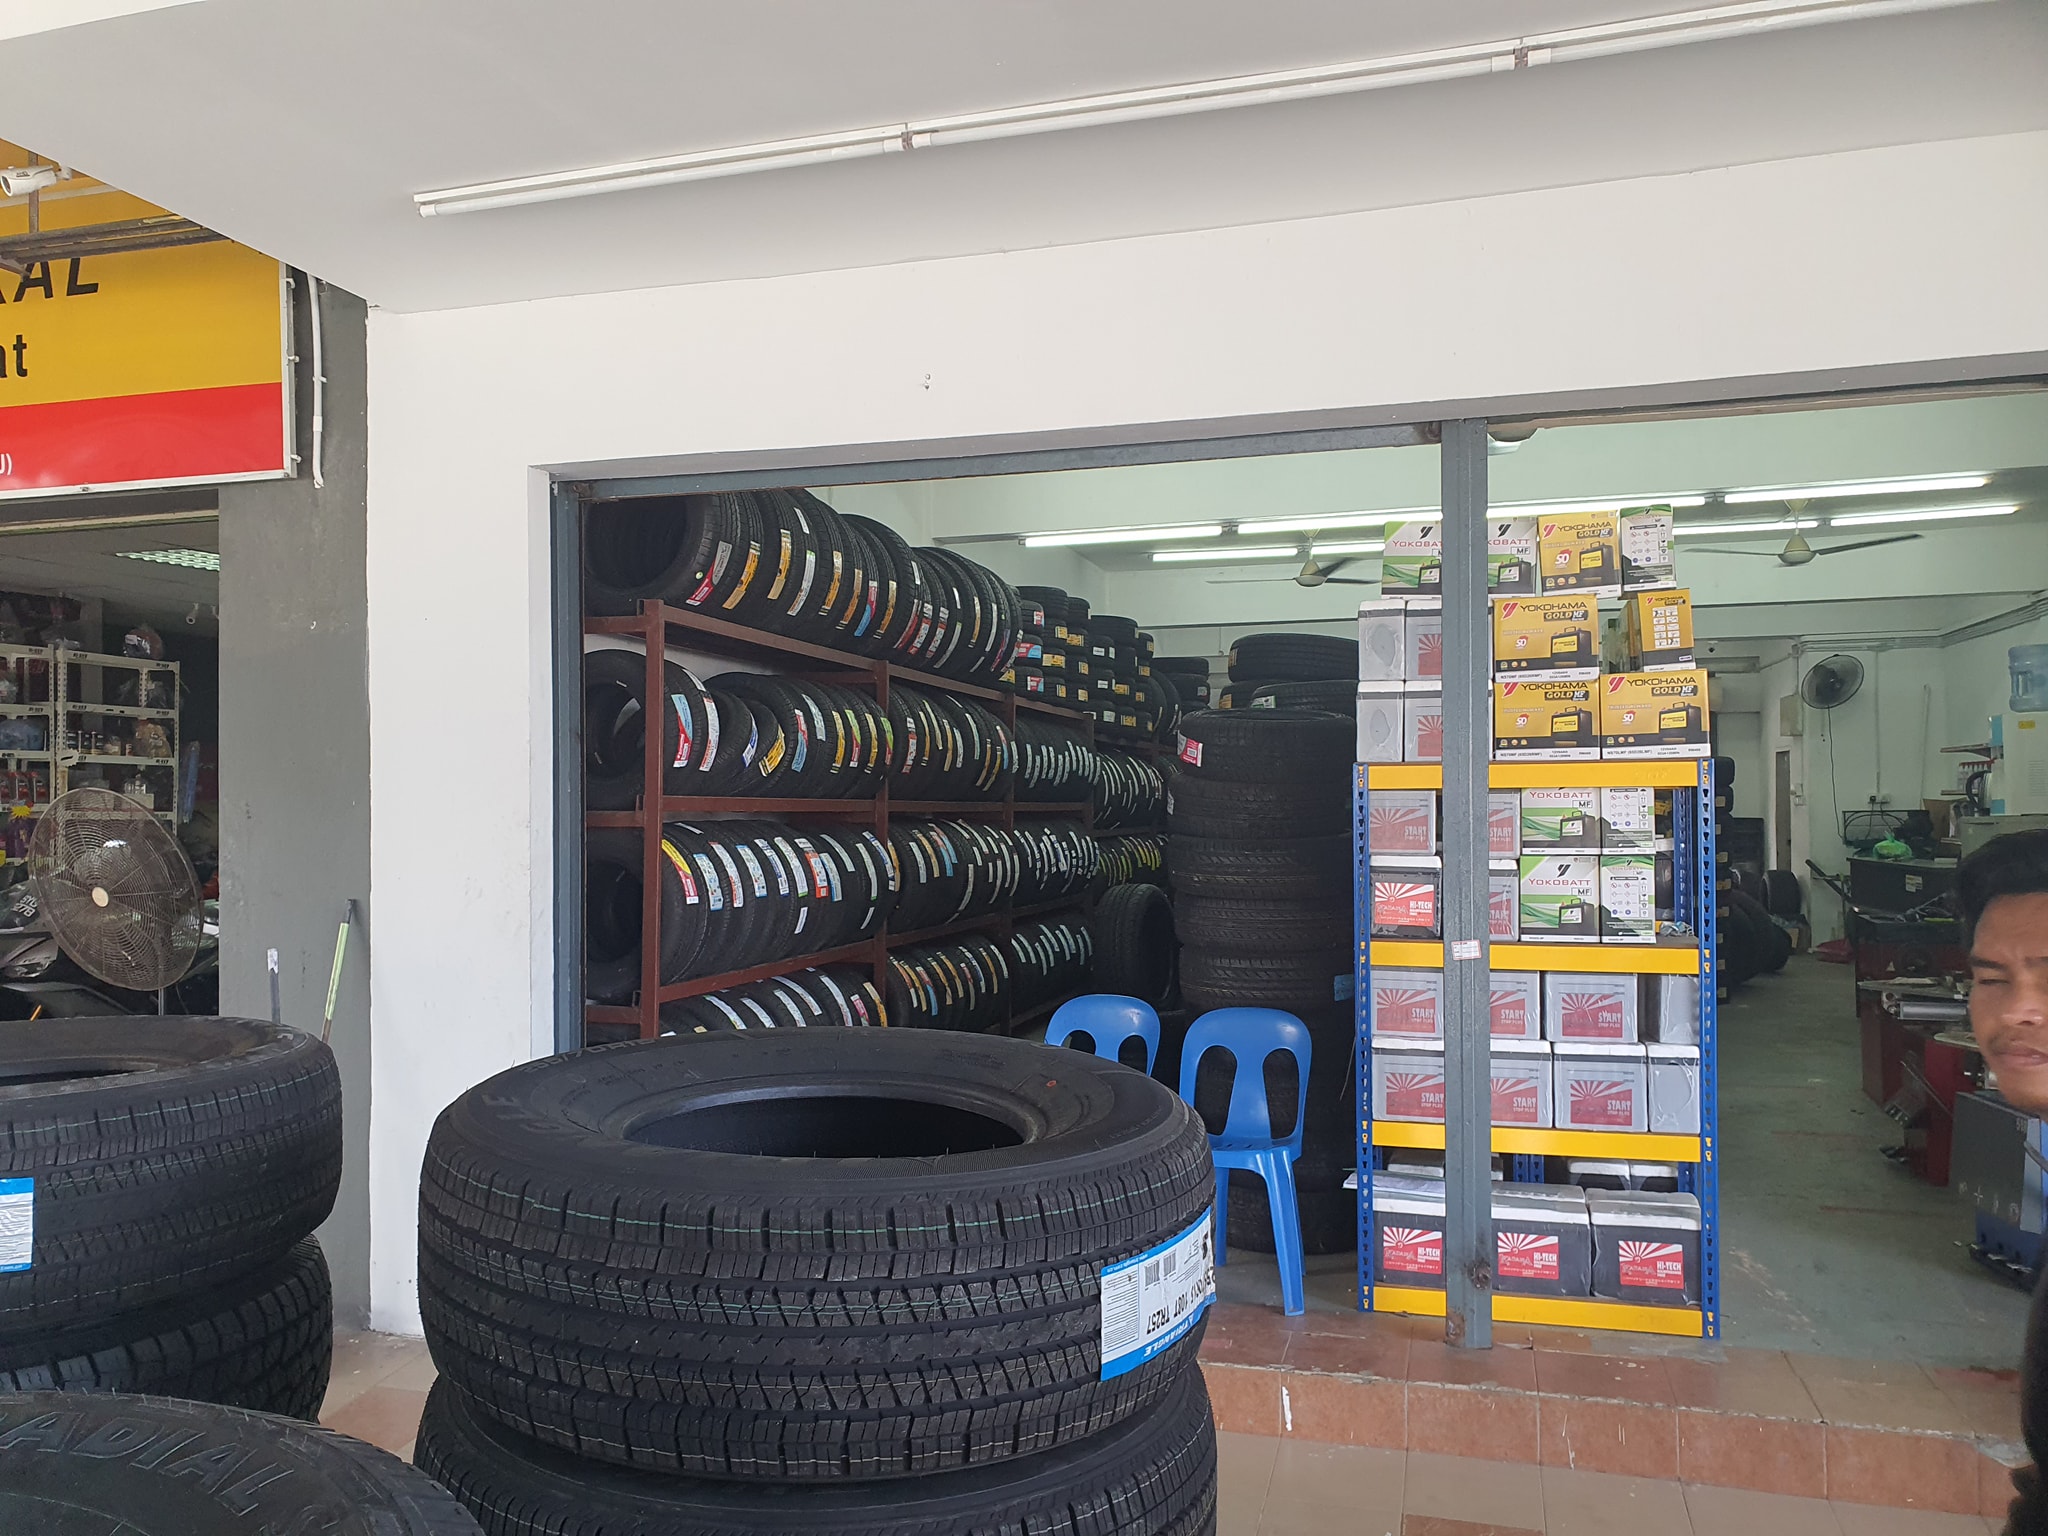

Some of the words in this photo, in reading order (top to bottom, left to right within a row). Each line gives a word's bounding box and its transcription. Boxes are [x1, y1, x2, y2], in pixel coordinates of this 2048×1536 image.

[0, 257, 99, 304] AL
[1557, 521, 1612, 532] YOKOHAMA
[1578, 530, 1600, 538] GOLD
[1516, 547, 1529, 555] MF
[1520, 602, 1587, 612] YOKOHAMA
[1545, 612, 1572, 620] GOLD
[1521, 682, 1588, 691] YOKOHAMA
[1627, 677, 1696, 687] YOKOHAMA
[1652, 686, 1681, 695] GOLD
[1529, 791, 1592, 799] YOKOBATT
[1404, 825, 1427, 836] START
[1409, 900, 1433, 910] HI-TECH
[1411, 1007, 1435, 1018] START
[1501, 1008, 1525, 1019] START
[1598, 1012, 1622, 1023] START
[1421, 1092, 1444, 1103] START
[1512, 1096, 1537, 1107] START
[1607, 1100, 1631, 1110] START
[1417, 1246, 1441, 1257] HI-TECH
[1533, 1251, 1557, 1262] HI-TECH
[1656, 1260, 1681, 1271] HI-TECH
[1146, 1305, 1171, 1335] TR257
[1143, 1322, 1189, 1357] TRIANGLE
[0, 1411, 295, 1517] ADIAL
